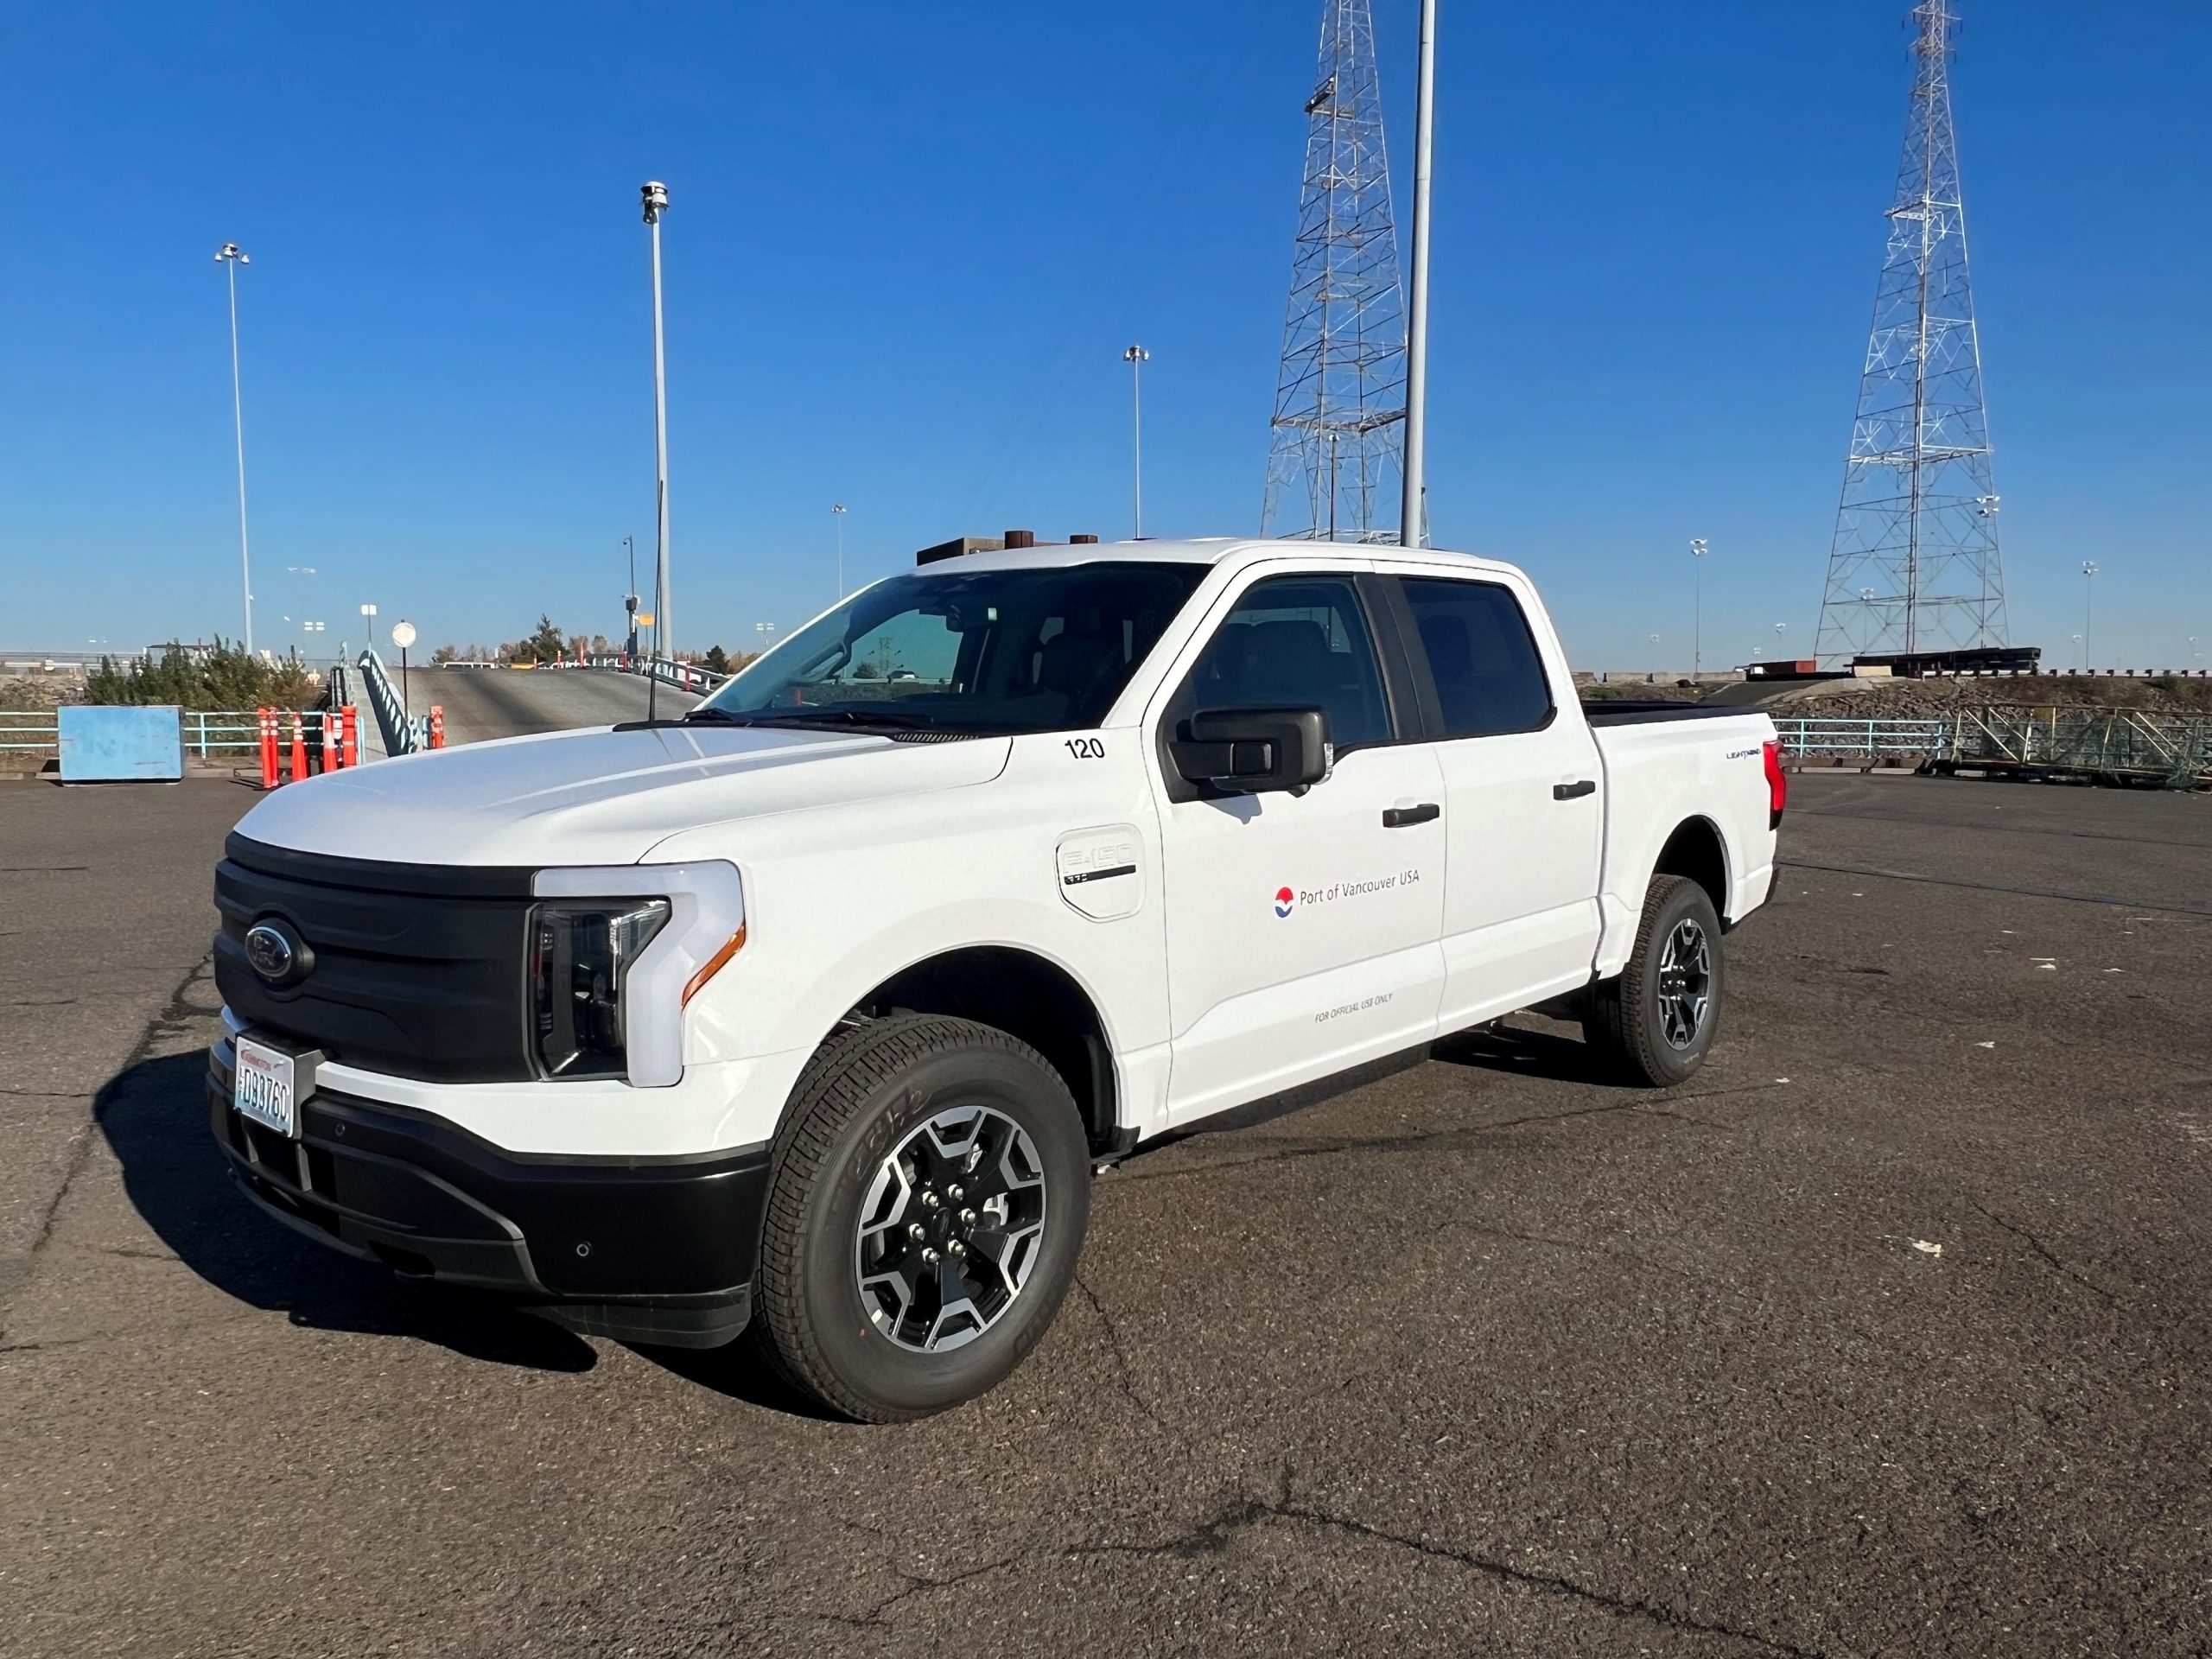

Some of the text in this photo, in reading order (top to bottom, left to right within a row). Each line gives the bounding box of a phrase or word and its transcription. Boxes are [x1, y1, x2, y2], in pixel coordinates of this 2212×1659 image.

[1065, 738, 1105, 759] 120
[1300, 869, 1420, 906] Port of Vancouver USA
[1315, 1011, 1330, 1023] FOR
[1374, 993, 1393, 1006] ONLY
